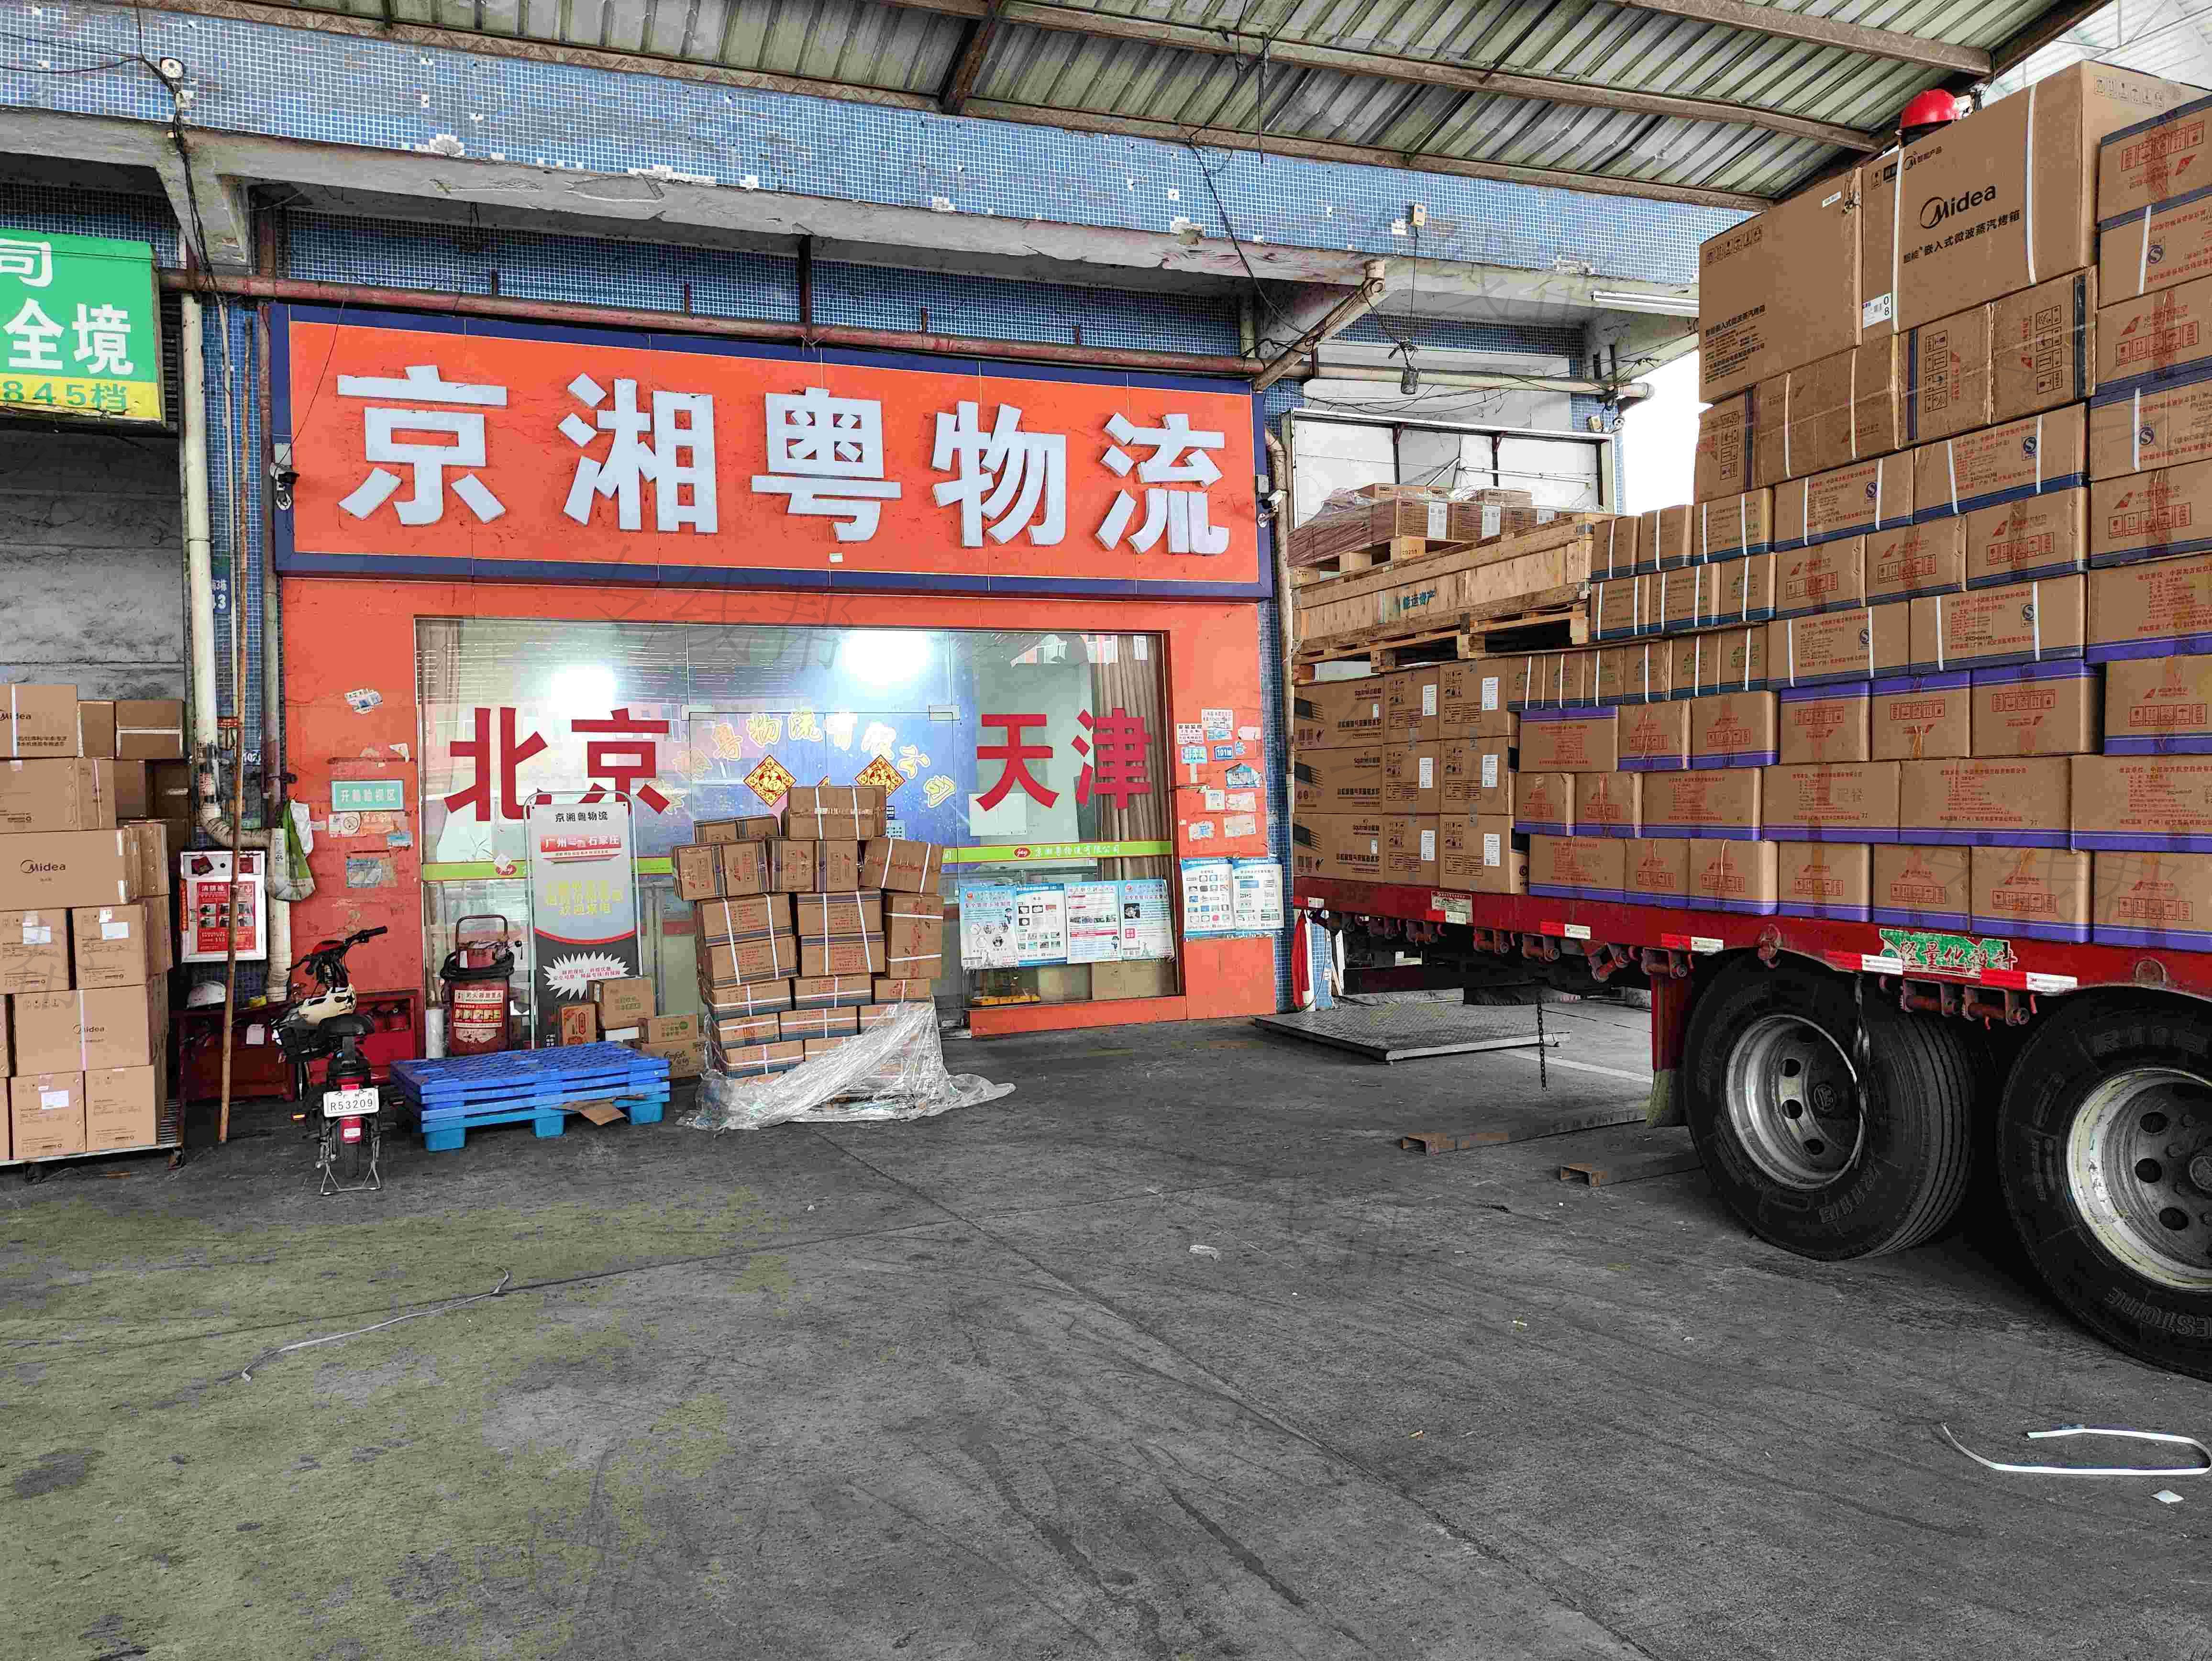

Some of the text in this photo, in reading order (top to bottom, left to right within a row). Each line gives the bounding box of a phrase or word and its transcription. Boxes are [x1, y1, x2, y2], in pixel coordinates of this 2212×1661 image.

[1920, 185, 1996, 229] Midea
[3, 297, 134, 376] 全境
[336, 365, 1229, 556] 京湘粤物流
[444, 707, 670, 821] 北京
[976, 708, 1153, 811] 天津
[554, 811, 609, 823] 京湘粤物流
[545, 834, 620, 849] 广州 石家庄
[20, 860, 66, 874] Midea
[330, 1099, 374, 1111] R53209
